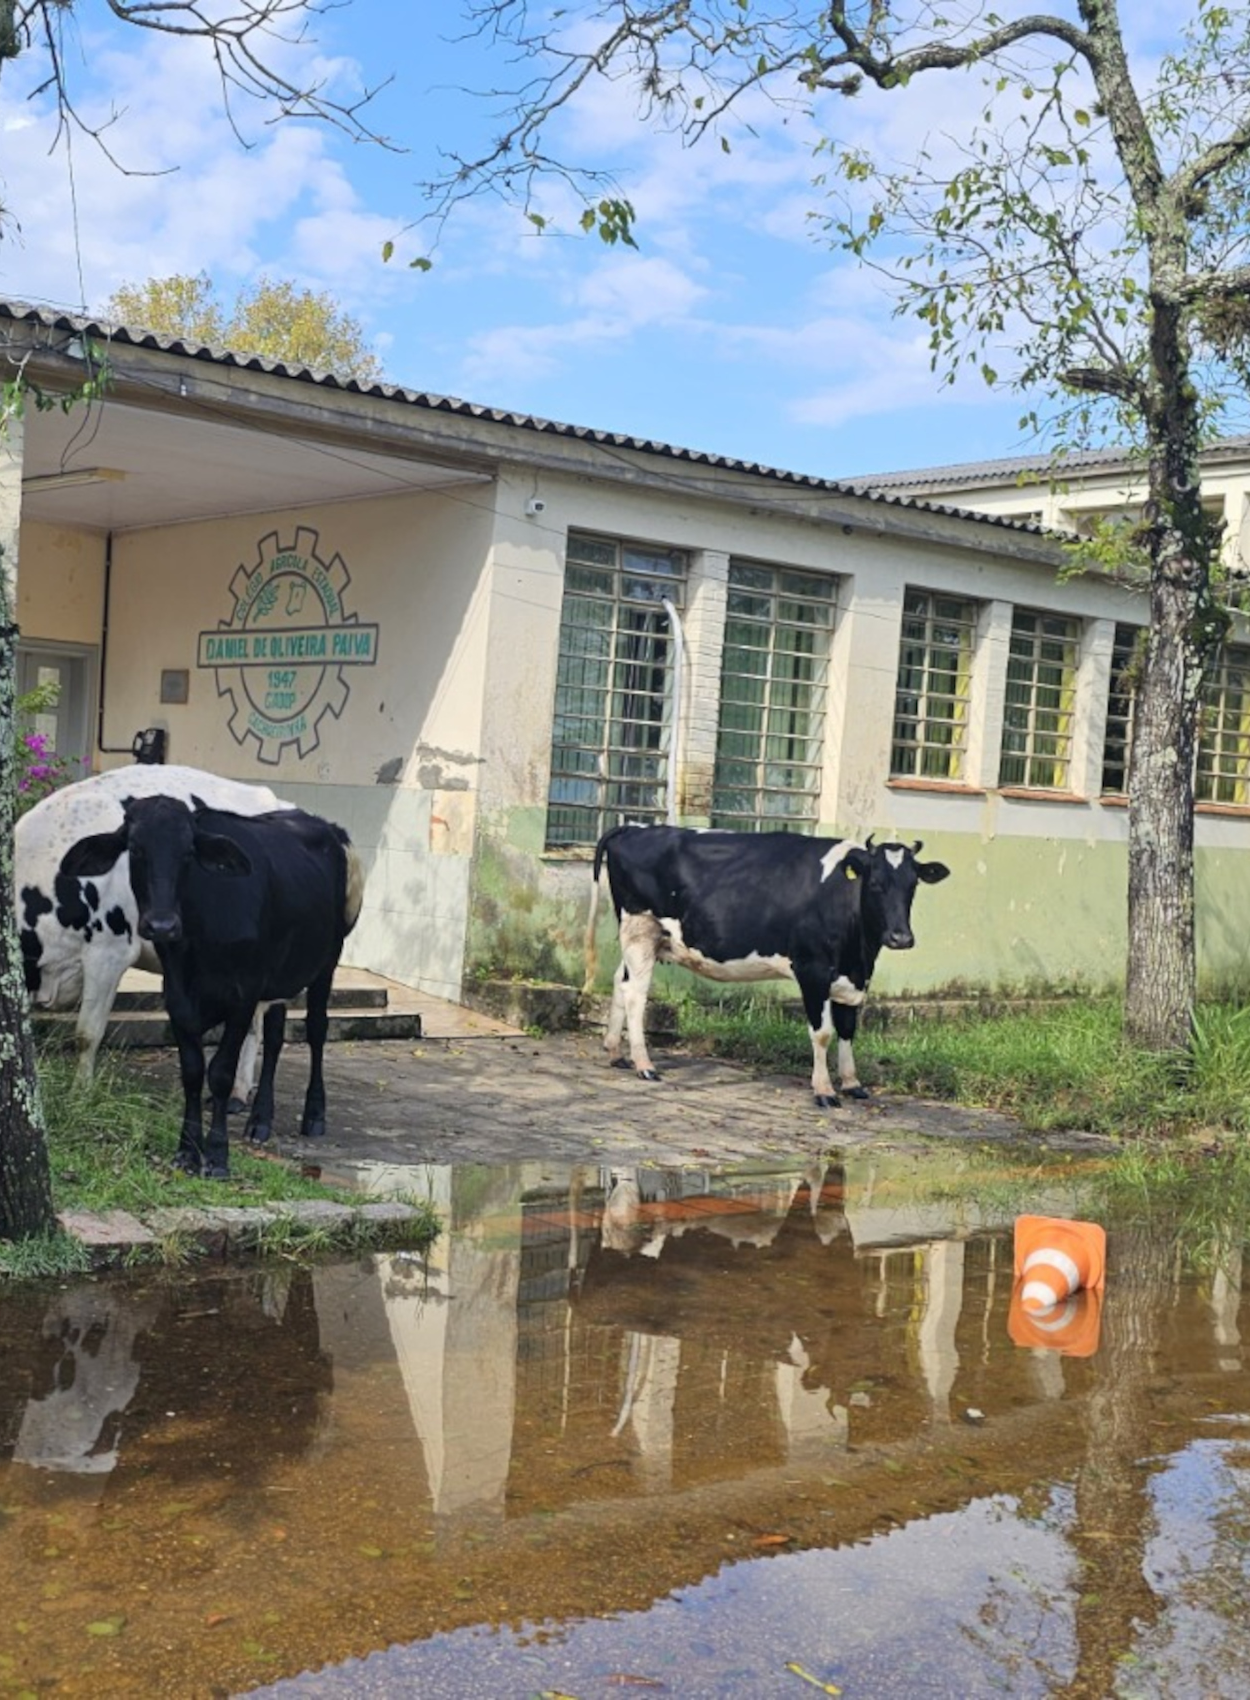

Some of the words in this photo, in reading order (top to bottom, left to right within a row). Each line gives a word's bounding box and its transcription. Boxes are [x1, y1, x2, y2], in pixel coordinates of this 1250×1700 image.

[206, 637, 248, 660] DANIEL
[253, 637, 267, 658] DE
[270, 634, 326, 658] OLIVEIRA
[332, 632, 371, 657] PAIVA
[268, 671, 297, 688] 1947
